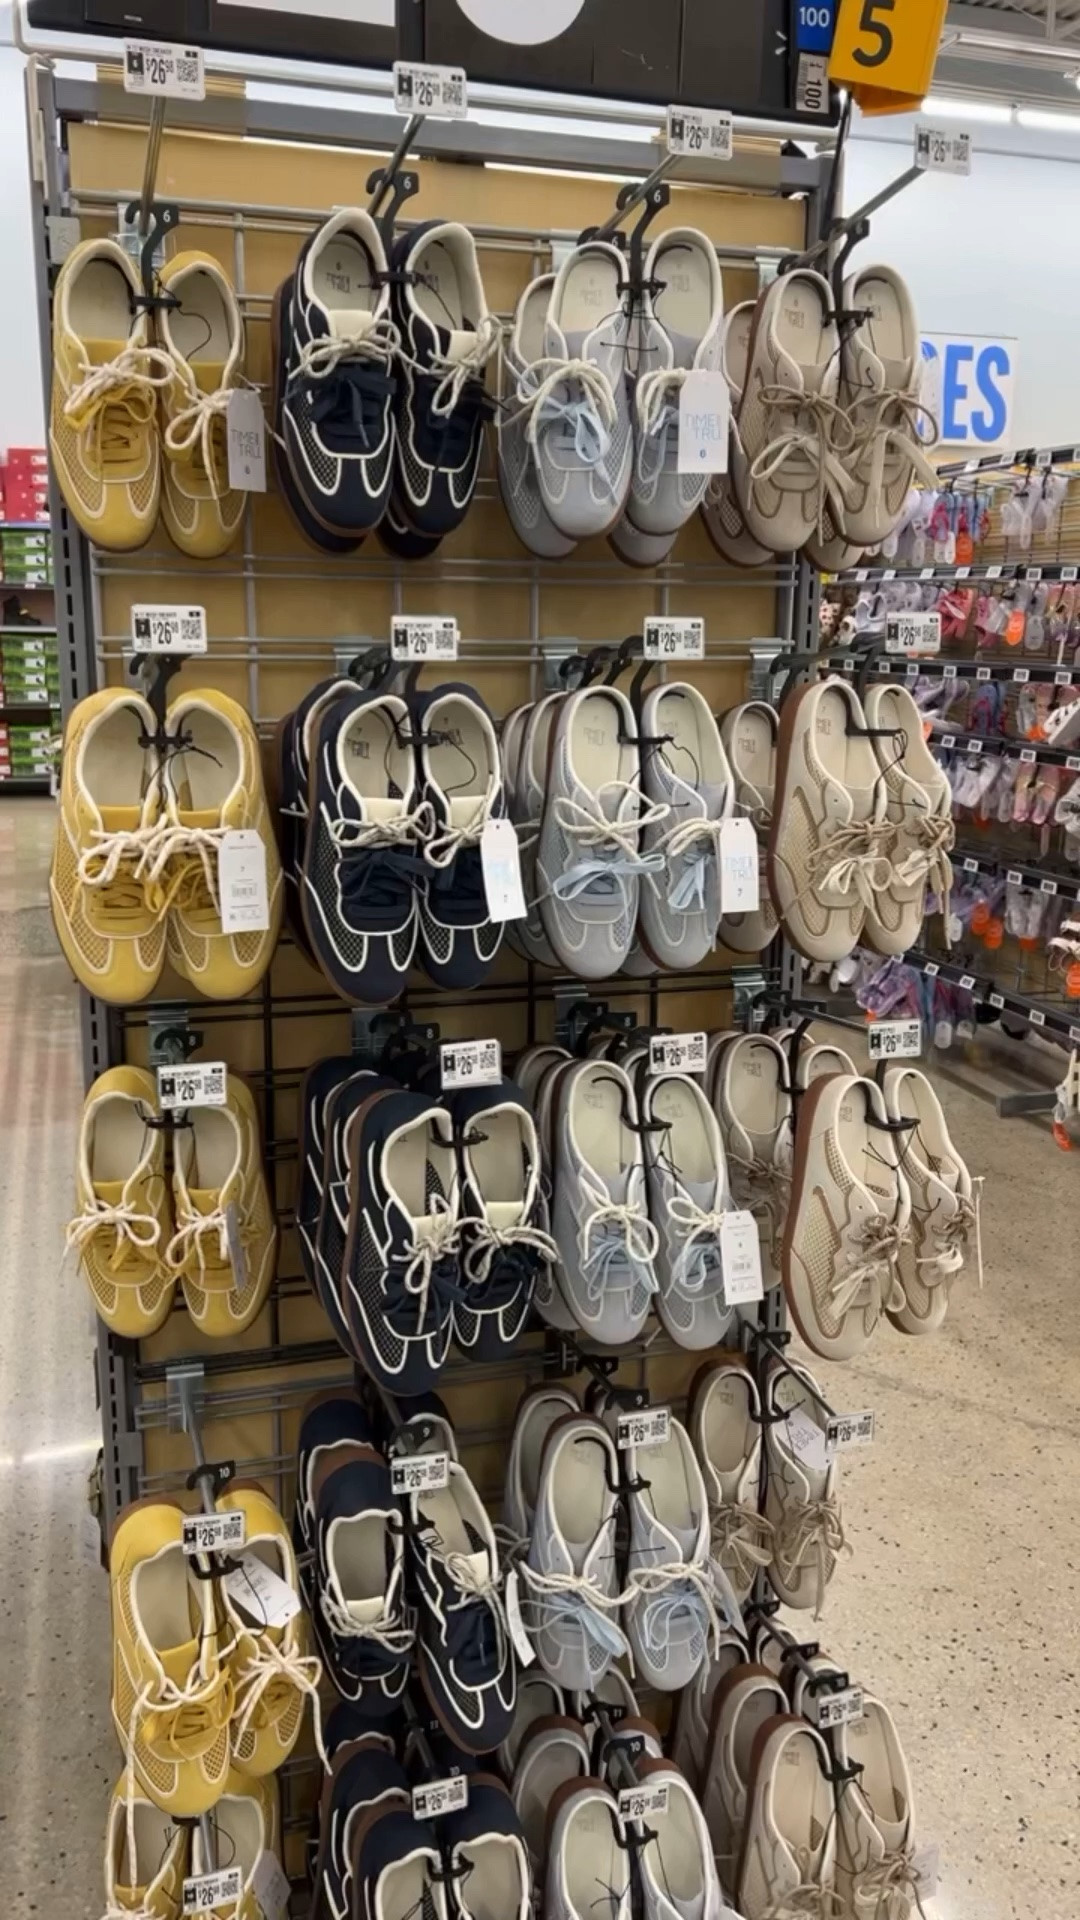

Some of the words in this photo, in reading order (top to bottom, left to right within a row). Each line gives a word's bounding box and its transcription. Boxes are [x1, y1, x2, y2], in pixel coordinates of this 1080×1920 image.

[800, 7, 829, 27] 100
[852, 0, 894, 67] 5
[804, 79, 822, 109] 100
[404, 176, 412, 190] 6
[653, 189, 661, 202] 6
[163, 210, 171, 222] 6
[426, 1028, 433, 1039] 8
[636, 1395, 643, 1405] 9
[218, 1467, 231, 1478] 10
[629, 1741, 641, 1752] 10
